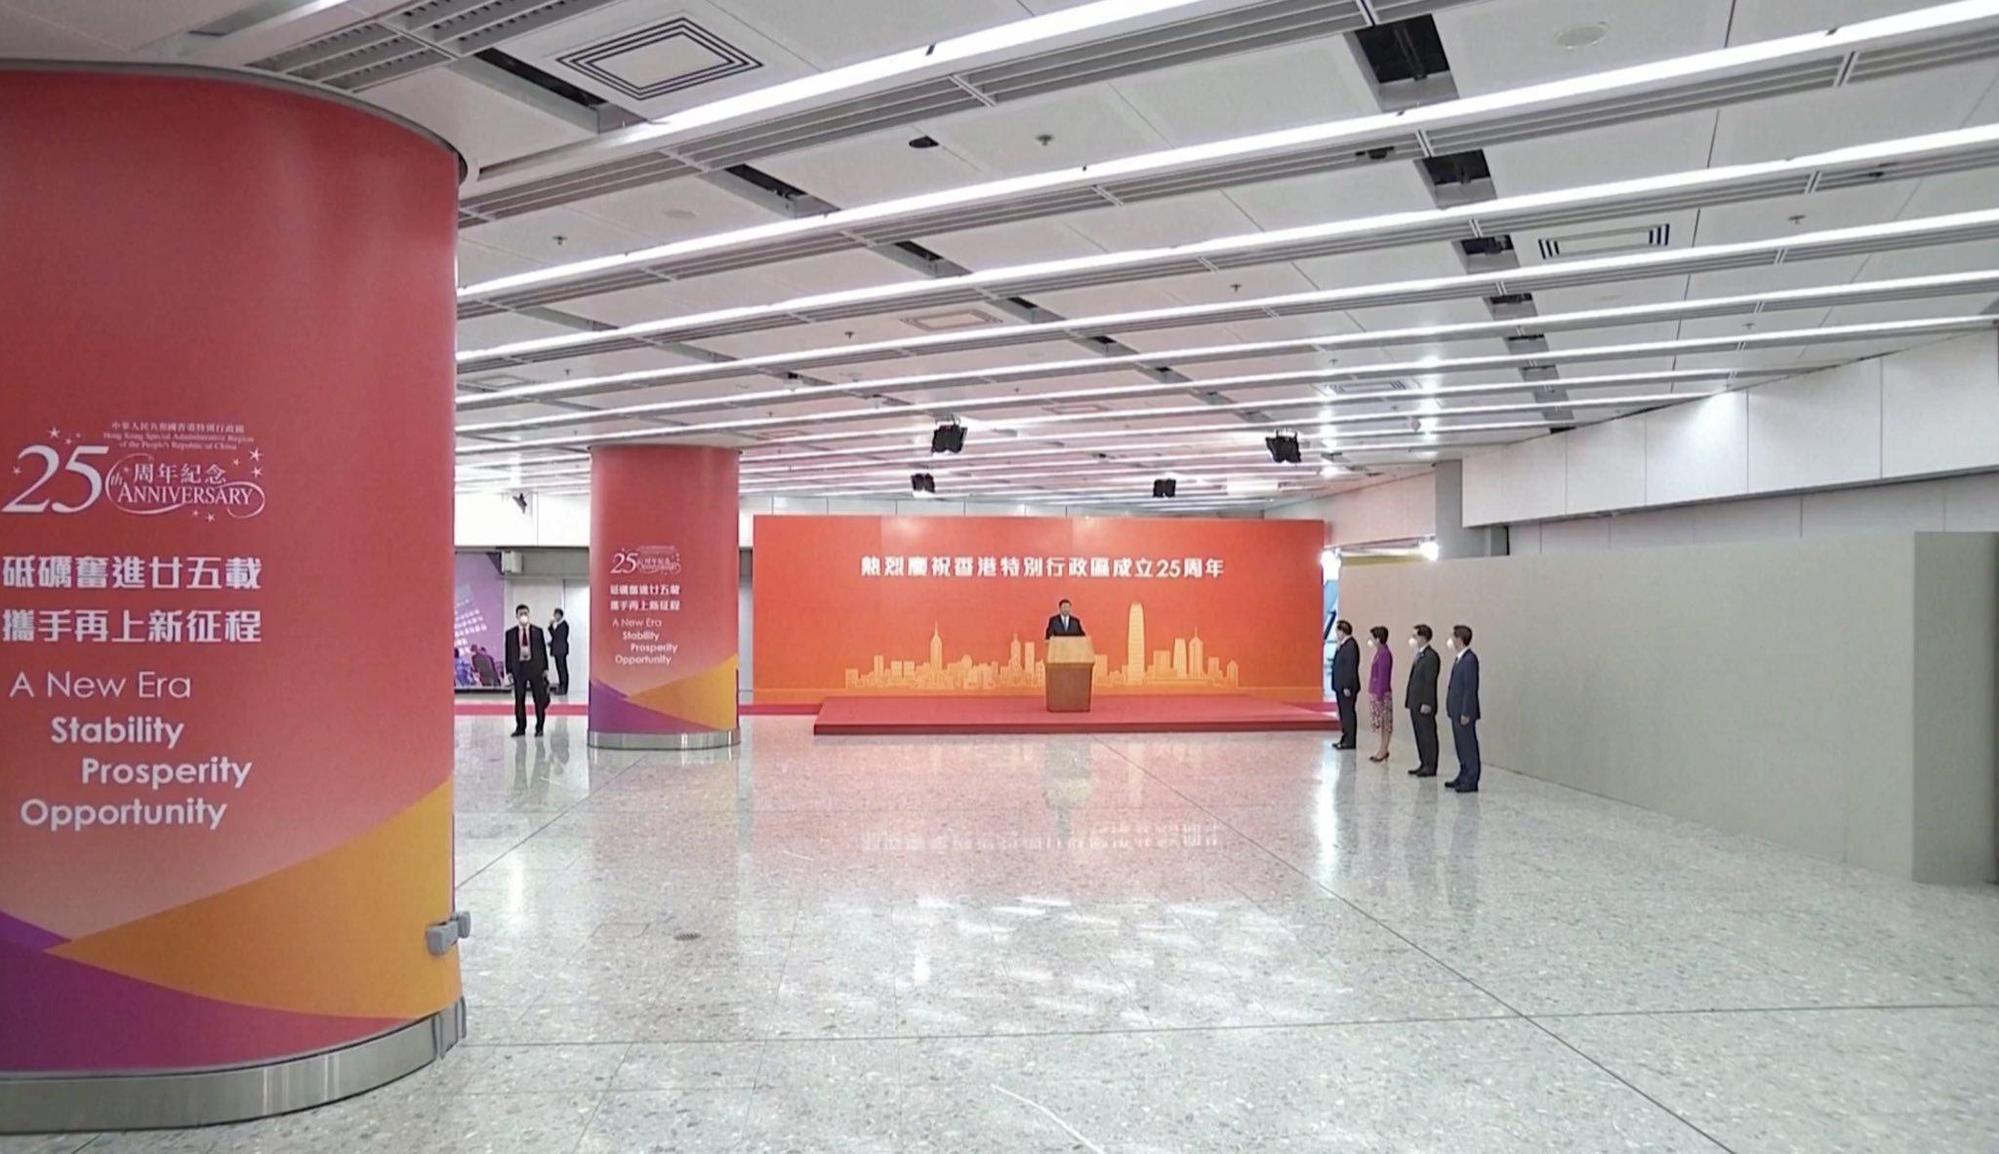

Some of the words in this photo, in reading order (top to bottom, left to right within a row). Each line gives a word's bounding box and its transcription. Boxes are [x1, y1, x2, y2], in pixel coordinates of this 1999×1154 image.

[134, 463, 227, 485] 周年紀念
[117, 483, 254, 505] ANNIVERSARY
[2, 555, 262, 589] 砥礪奮進廿五載
[861, 556, 1224, 578] 熱烈慶祝香港特別行政區成立25周年
[2, 609, 262, 642] 攜手再上新征程
[612, 618, 620, 628] A
[621, 618, 644, 628] New
[646, 617, 662, 628] Era
[623, 630, 660, 642] Stability
[630, 642, 678, 653] Prosperity
[615, 654, 672, 666] Opportunity
[9, 671, 35, 698] A
[47, 671, 127, 698] New
[138, 671, 192, 698] Era
[51, 716, 184, 749] Stability
[82, 756, 252, 790] Prosperity
[20, 797, 228, 831] Opportunity
